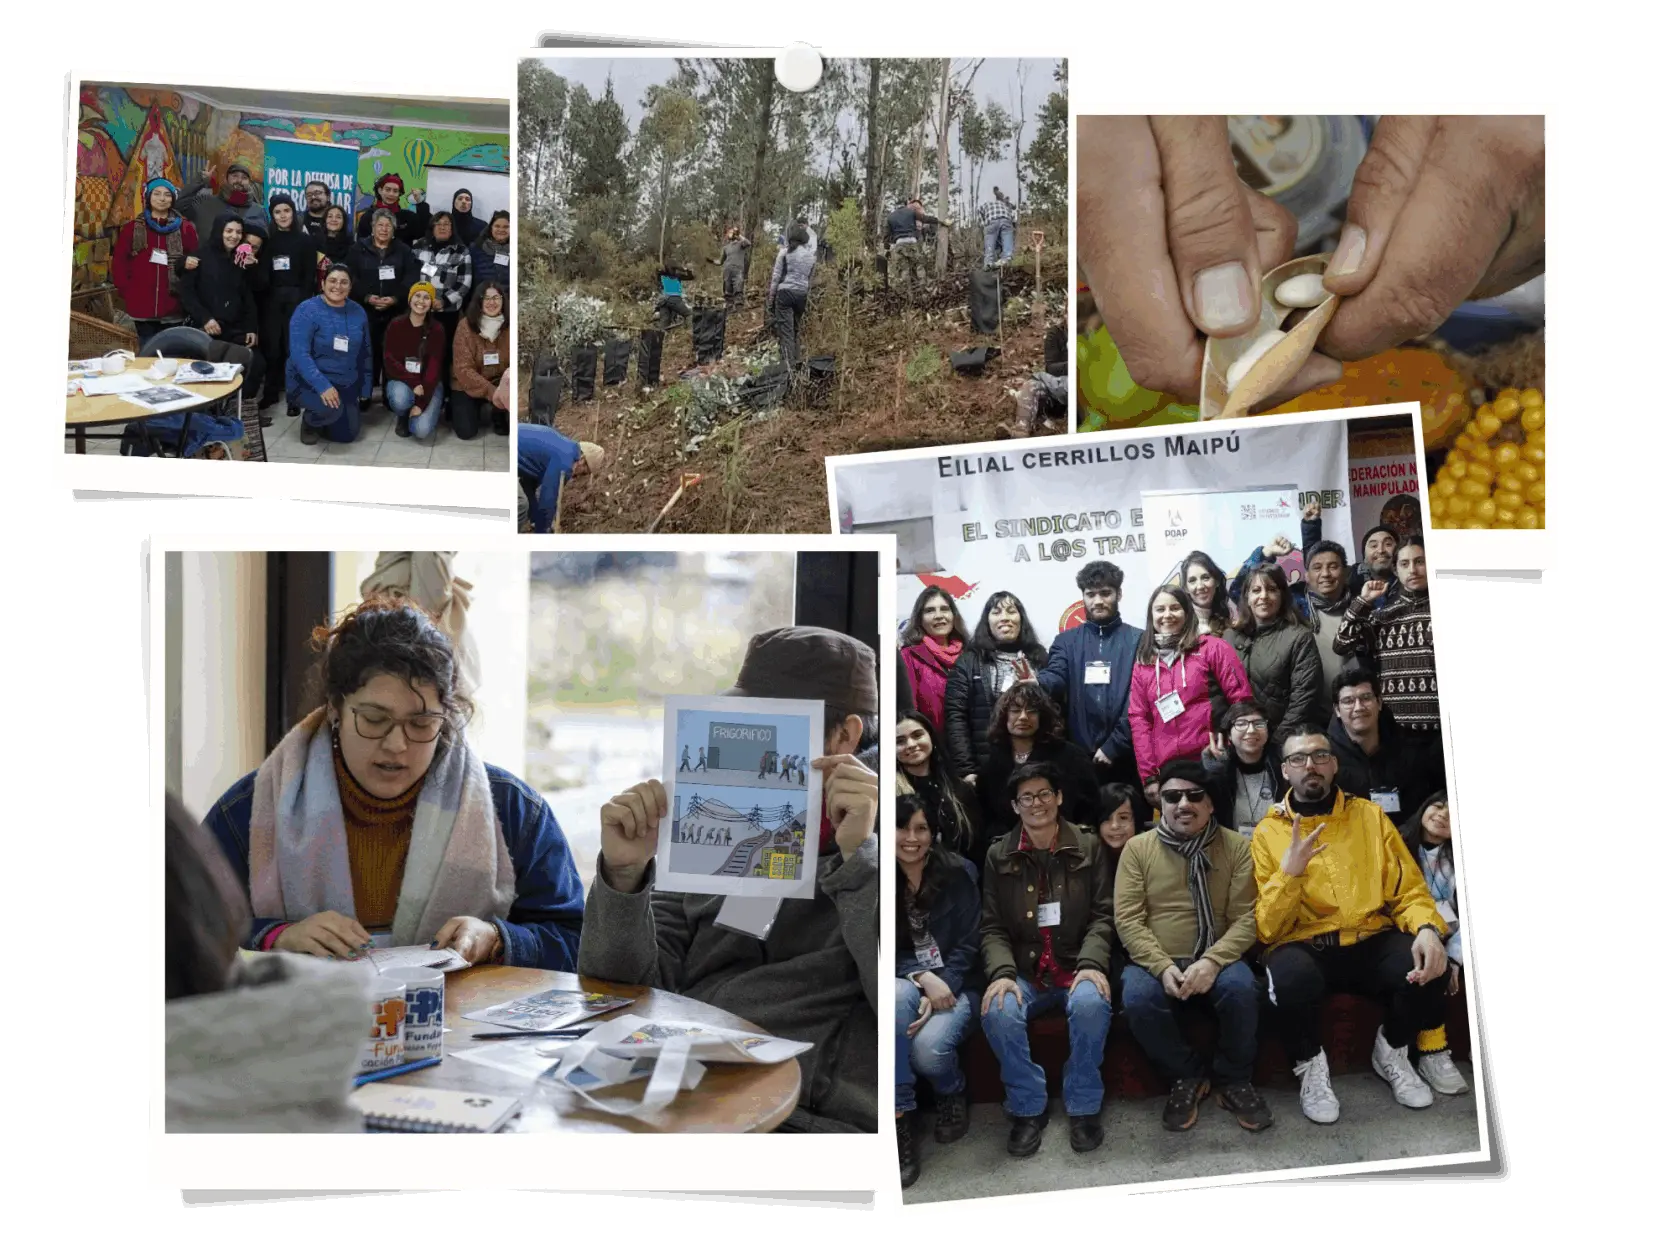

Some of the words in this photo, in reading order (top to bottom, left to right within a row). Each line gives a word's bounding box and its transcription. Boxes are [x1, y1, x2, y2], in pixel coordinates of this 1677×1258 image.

[268, 168, 289, 186] POR
[291, 170, 302, 187] LA
[343, 174, 353, 190] DE
[1022, 443, 1155, 469] CERRILLOS
[1349, 461, 1406, 481] DERACIÓN
[962, 522, 988, 542] EL
[995, 510, 1121, 538] SINDICATO
[1014, 544, 1031, 562] A
[1038, 538, 1087, 562] L@S
